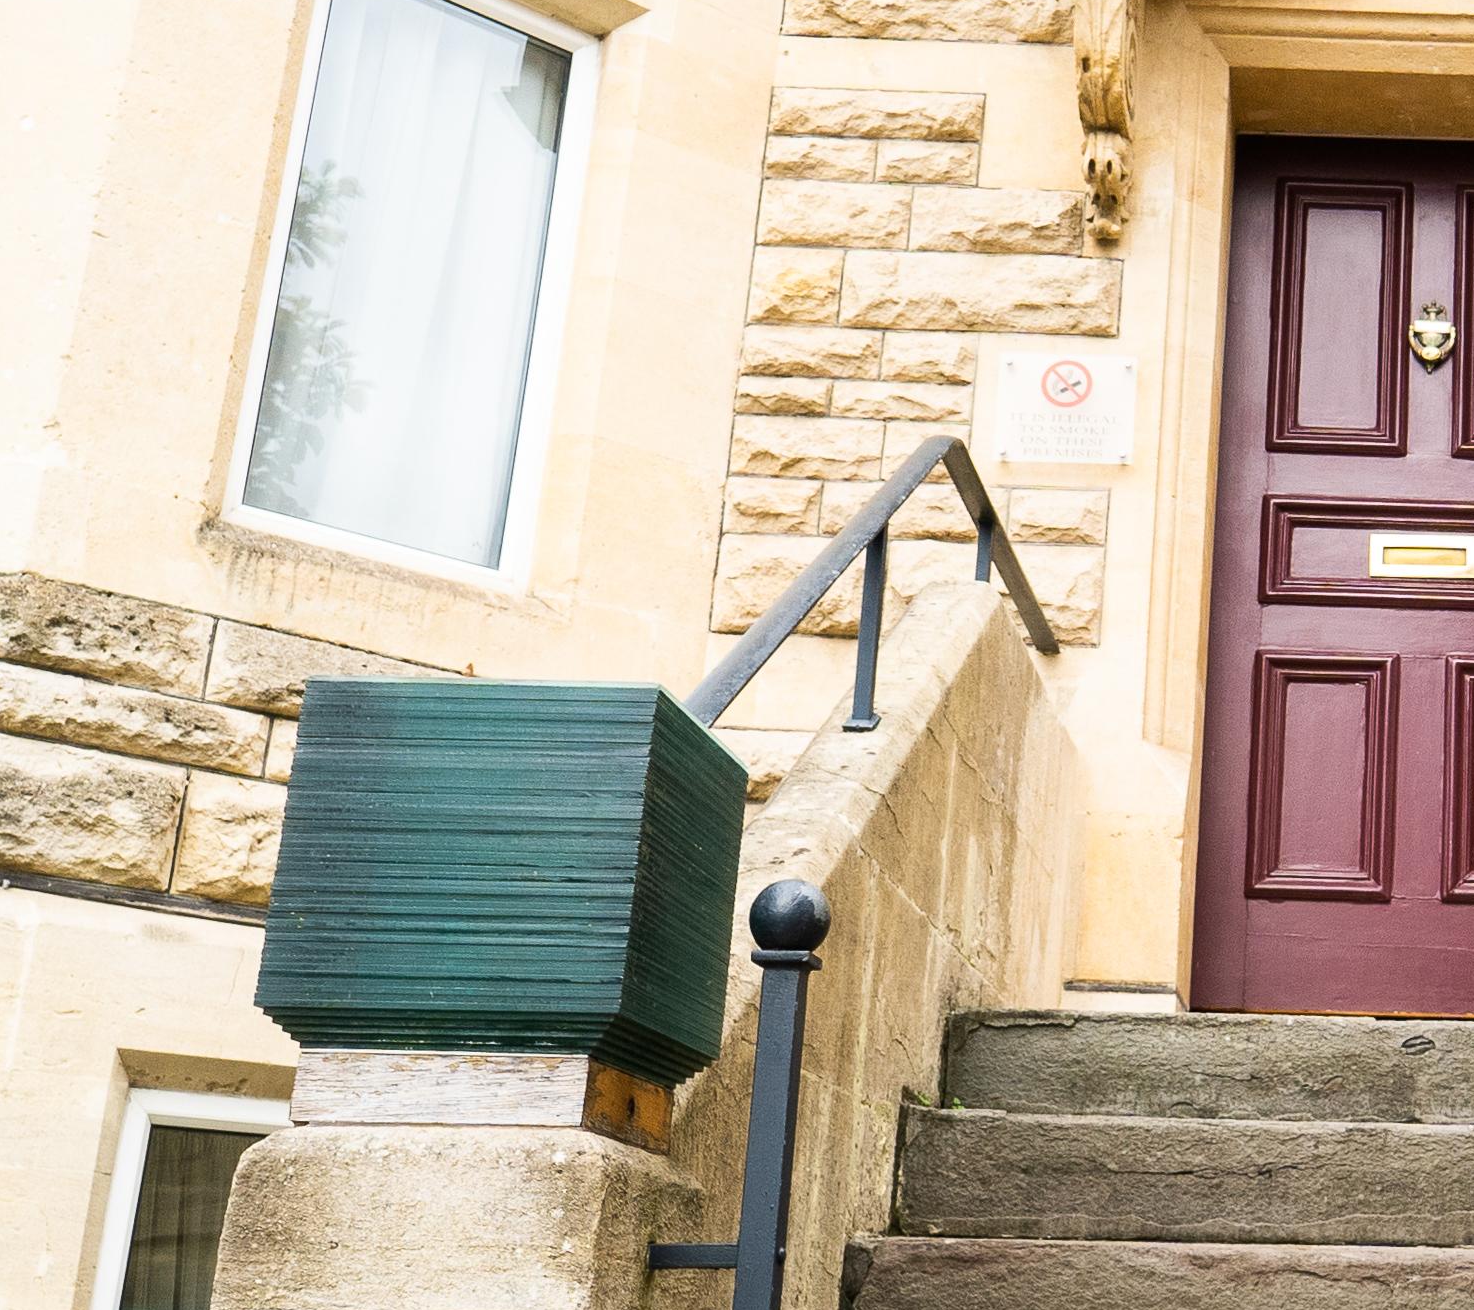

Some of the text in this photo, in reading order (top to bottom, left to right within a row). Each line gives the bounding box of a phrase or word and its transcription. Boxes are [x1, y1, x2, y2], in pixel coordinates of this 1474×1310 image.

[1010, 412, 1120, 425] IT IS ILLEGAL
[1020, 425, 1111, 435] TO SMOKE
[1020, 435, 1106, 447] ON THESE
[1022, 447, 1103, 458] PREMISES
